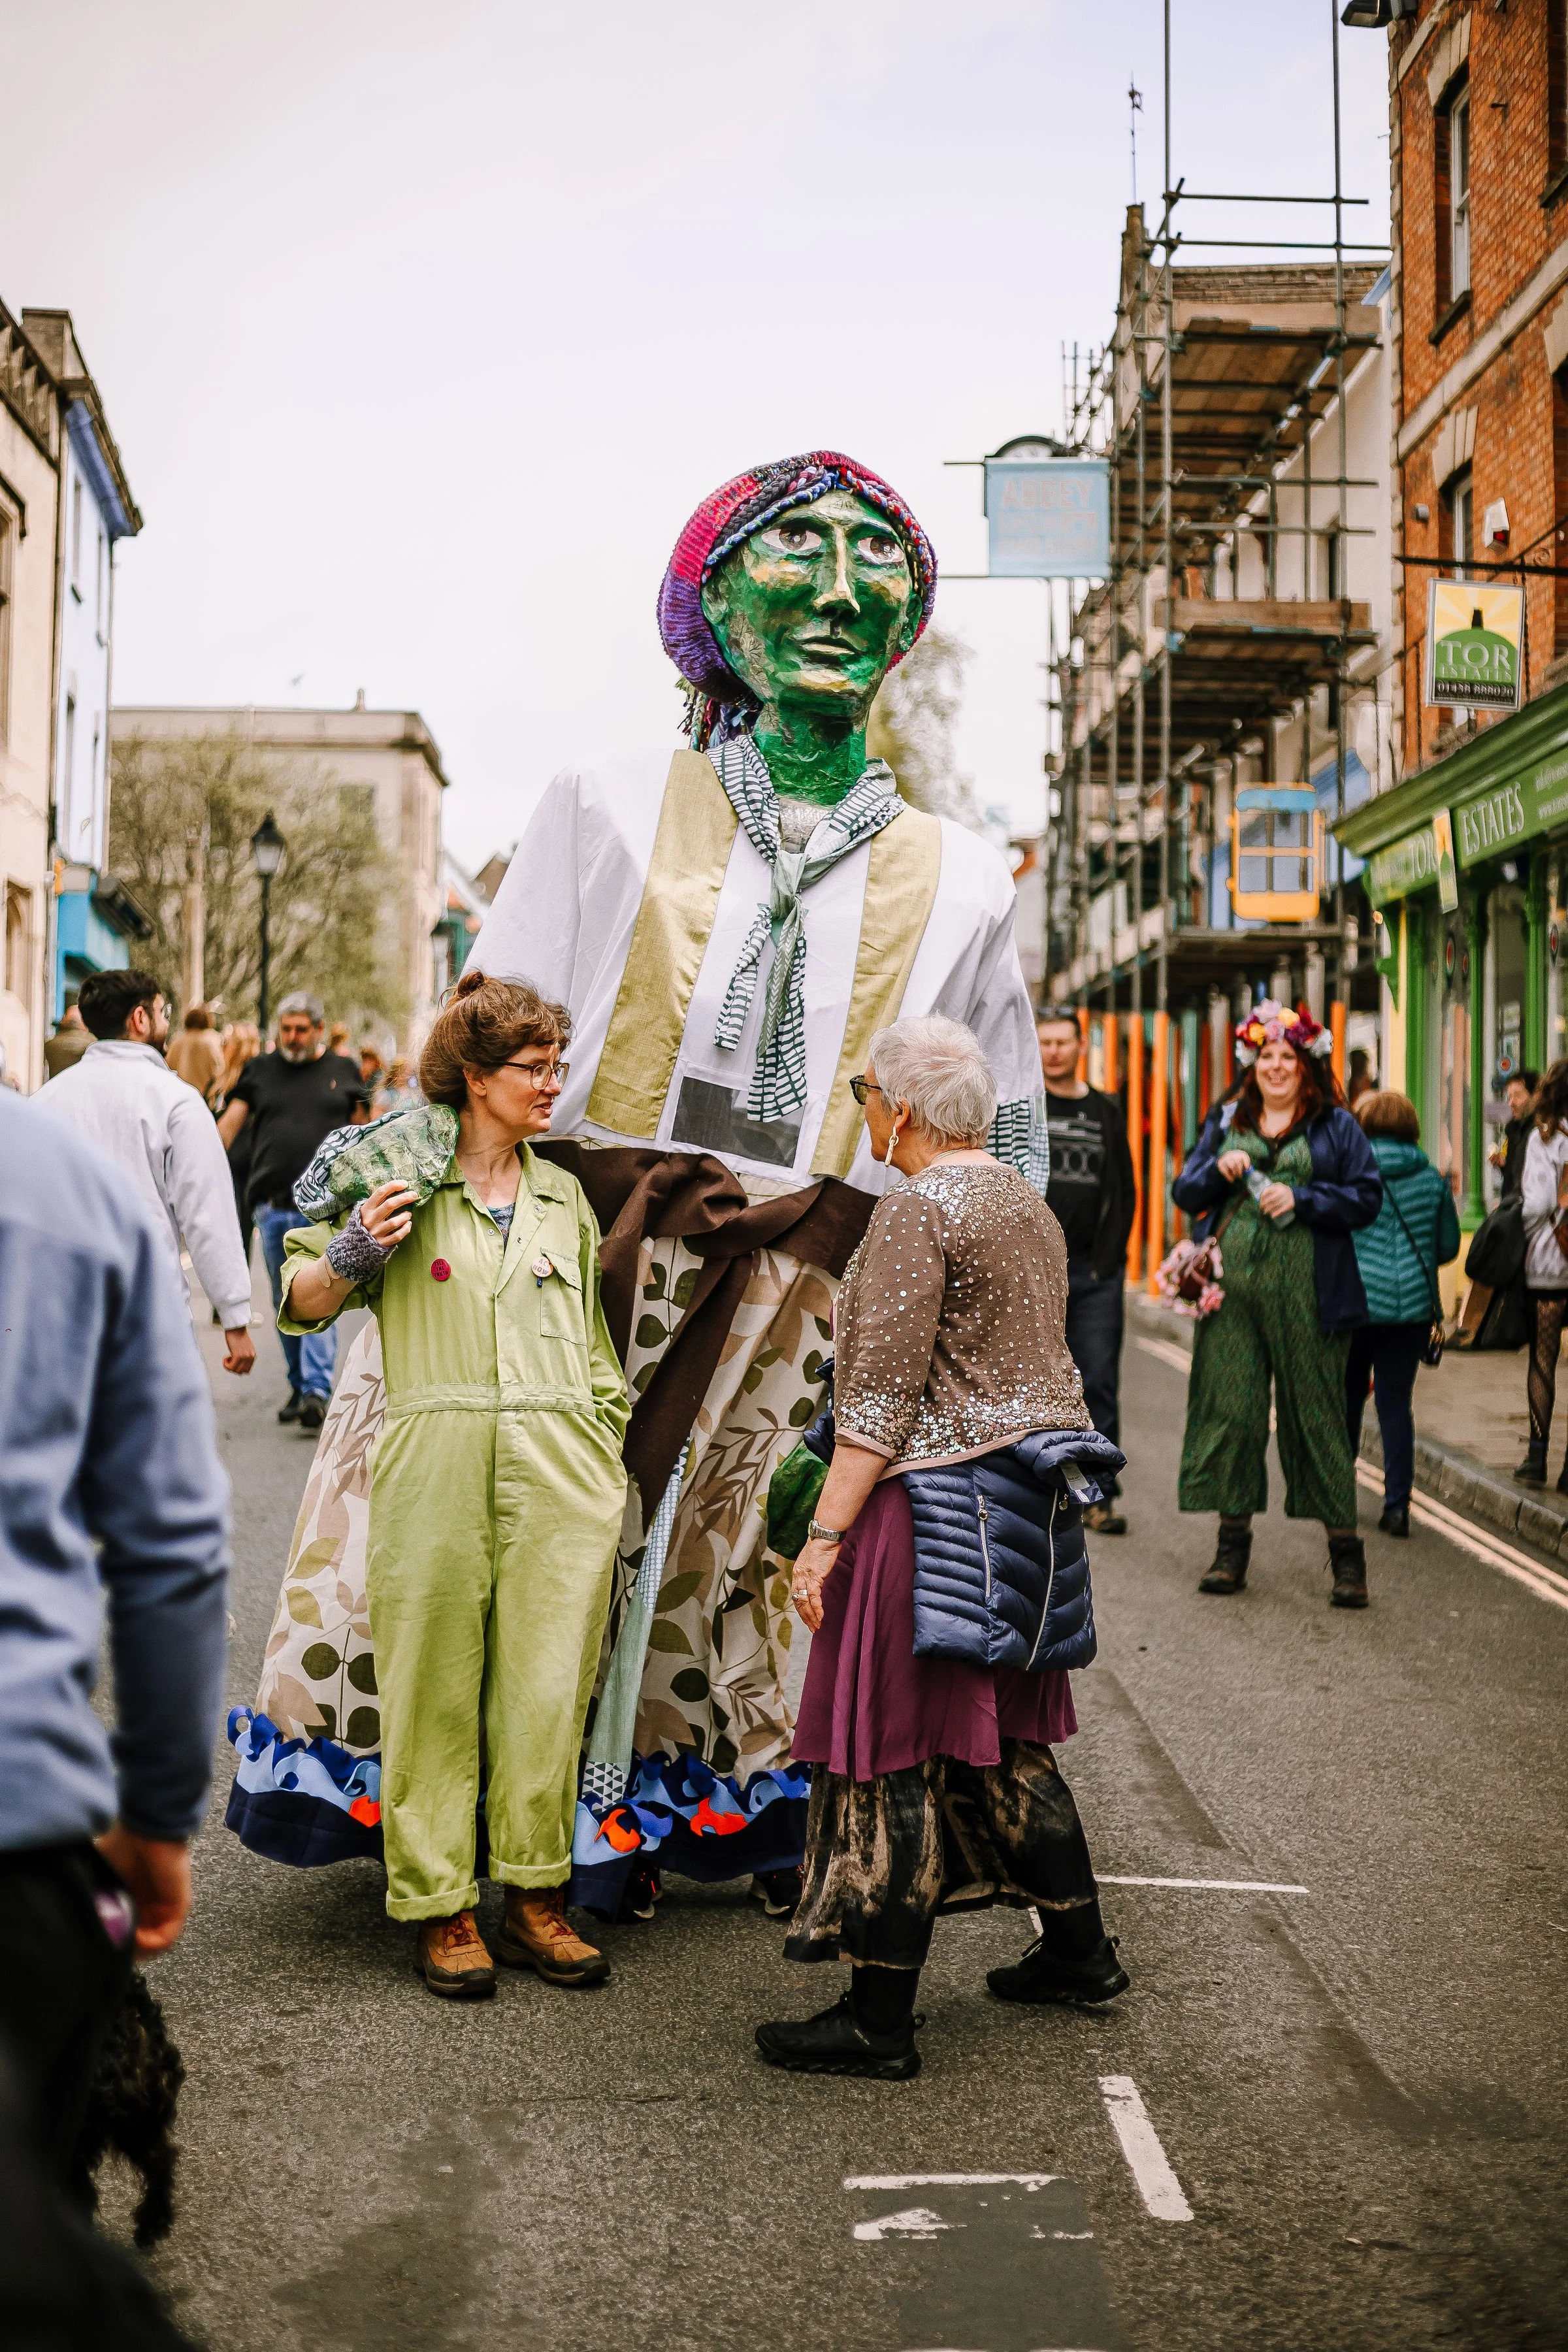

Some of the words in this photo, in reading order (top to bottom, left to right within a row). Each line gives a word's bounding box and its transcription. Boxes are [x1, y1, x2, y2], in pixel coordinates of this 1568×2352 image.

[1002, 478, 1094, 508] ABBEY
[1439, 640, 1511, 670] TOR
[1406, 830, 1438, 882] TOR
[1460, 781, 1524, 856] ESTATES
[532, 1264, 549, 1275] NOW
